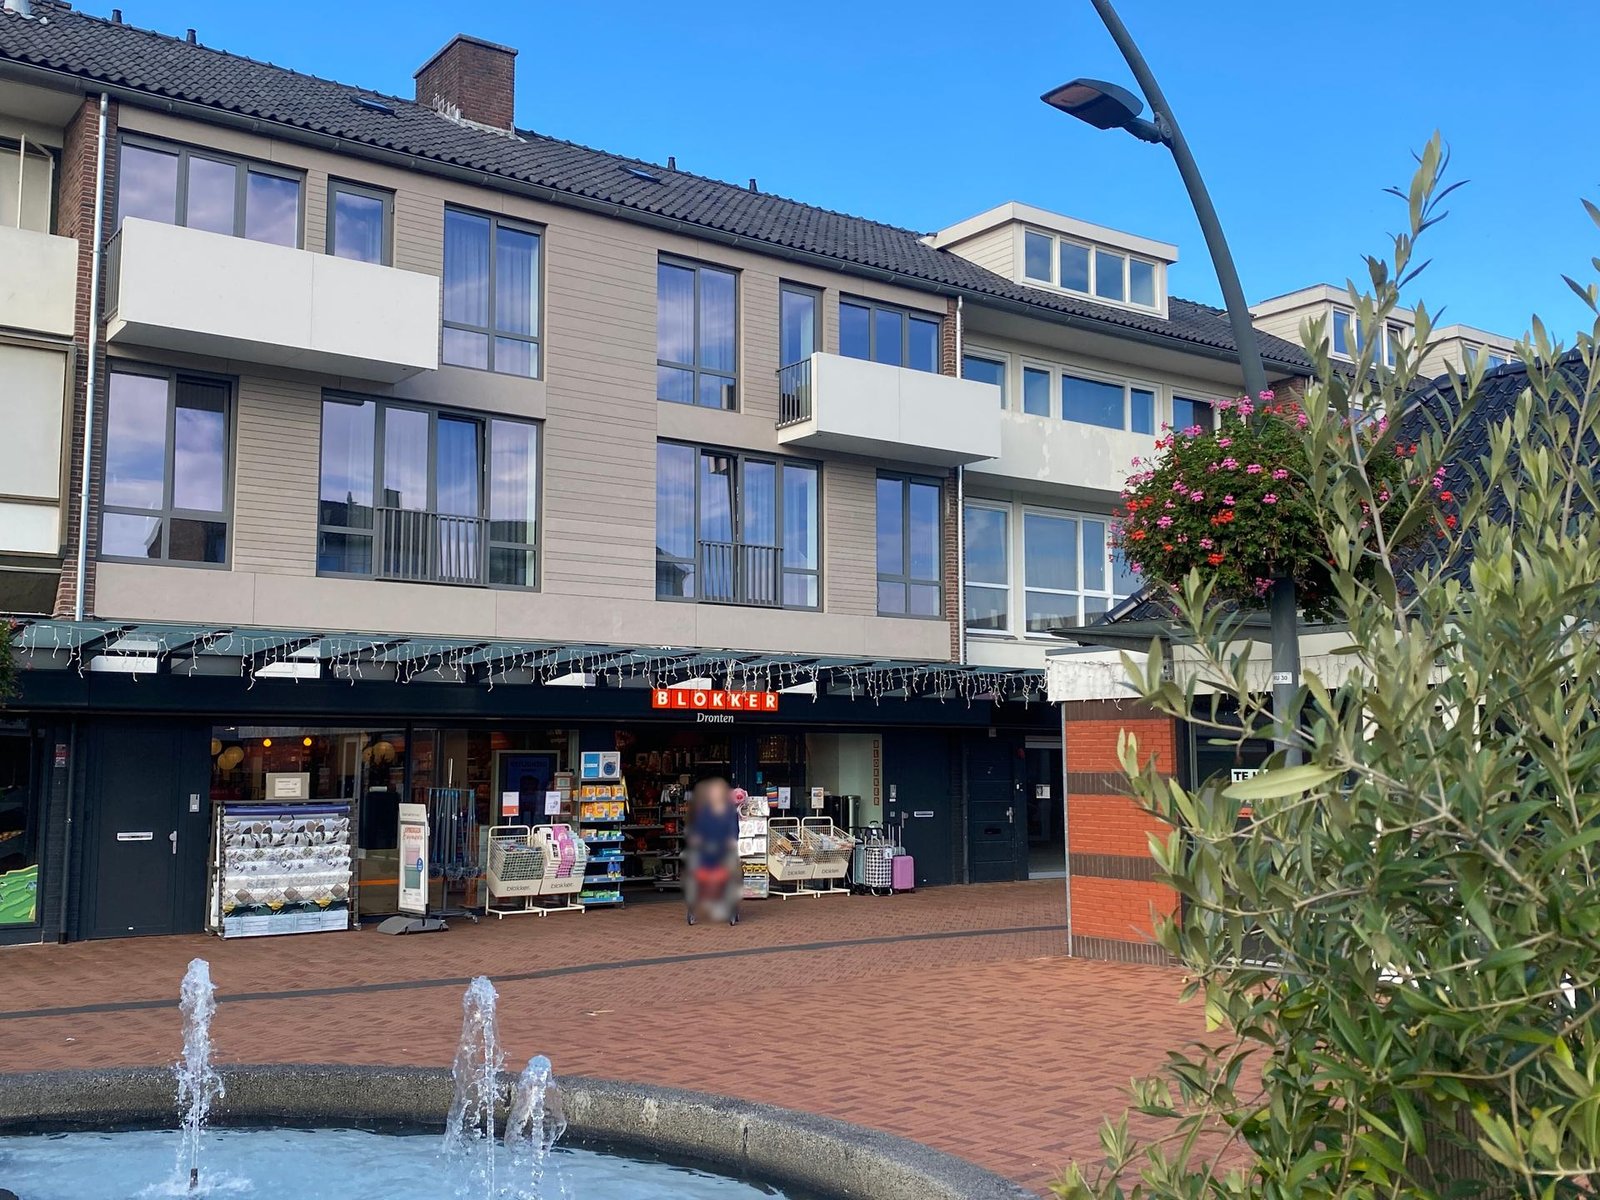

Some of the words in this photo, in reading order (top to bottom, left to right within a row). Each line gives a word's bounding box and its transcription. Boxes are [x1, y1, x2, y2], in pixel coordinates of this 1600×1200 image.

[656, 690, 776, 708] BLOKKER
[696, 712, 735, 723] Dronten
[1233, 771, 1249, 781] TE
